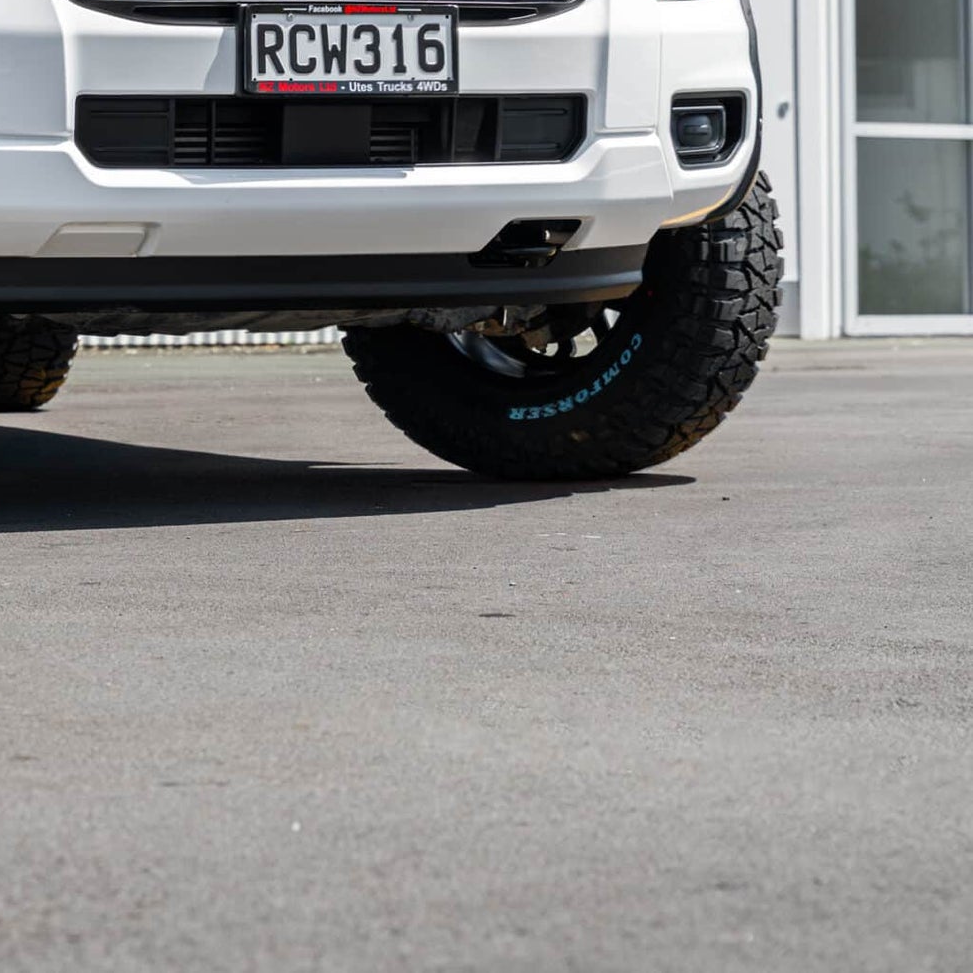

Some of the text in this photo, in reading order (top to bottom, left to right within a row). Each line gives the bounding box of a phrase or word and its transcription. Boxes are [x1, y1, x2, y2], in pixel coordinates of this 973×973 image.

[308, 4, 343, 13] Facebook
[257, 23, 445, 75] RCW316
[278, 80, 315, 92] Motors
[318, 80, 338, 92] Ltd
[349, 81, 373, 92] Utes
[377, 81, 413, 92] Trucks
[416, 81, 448, 92] 4WDs
[508, 333, 643, 420] COMFORSER
